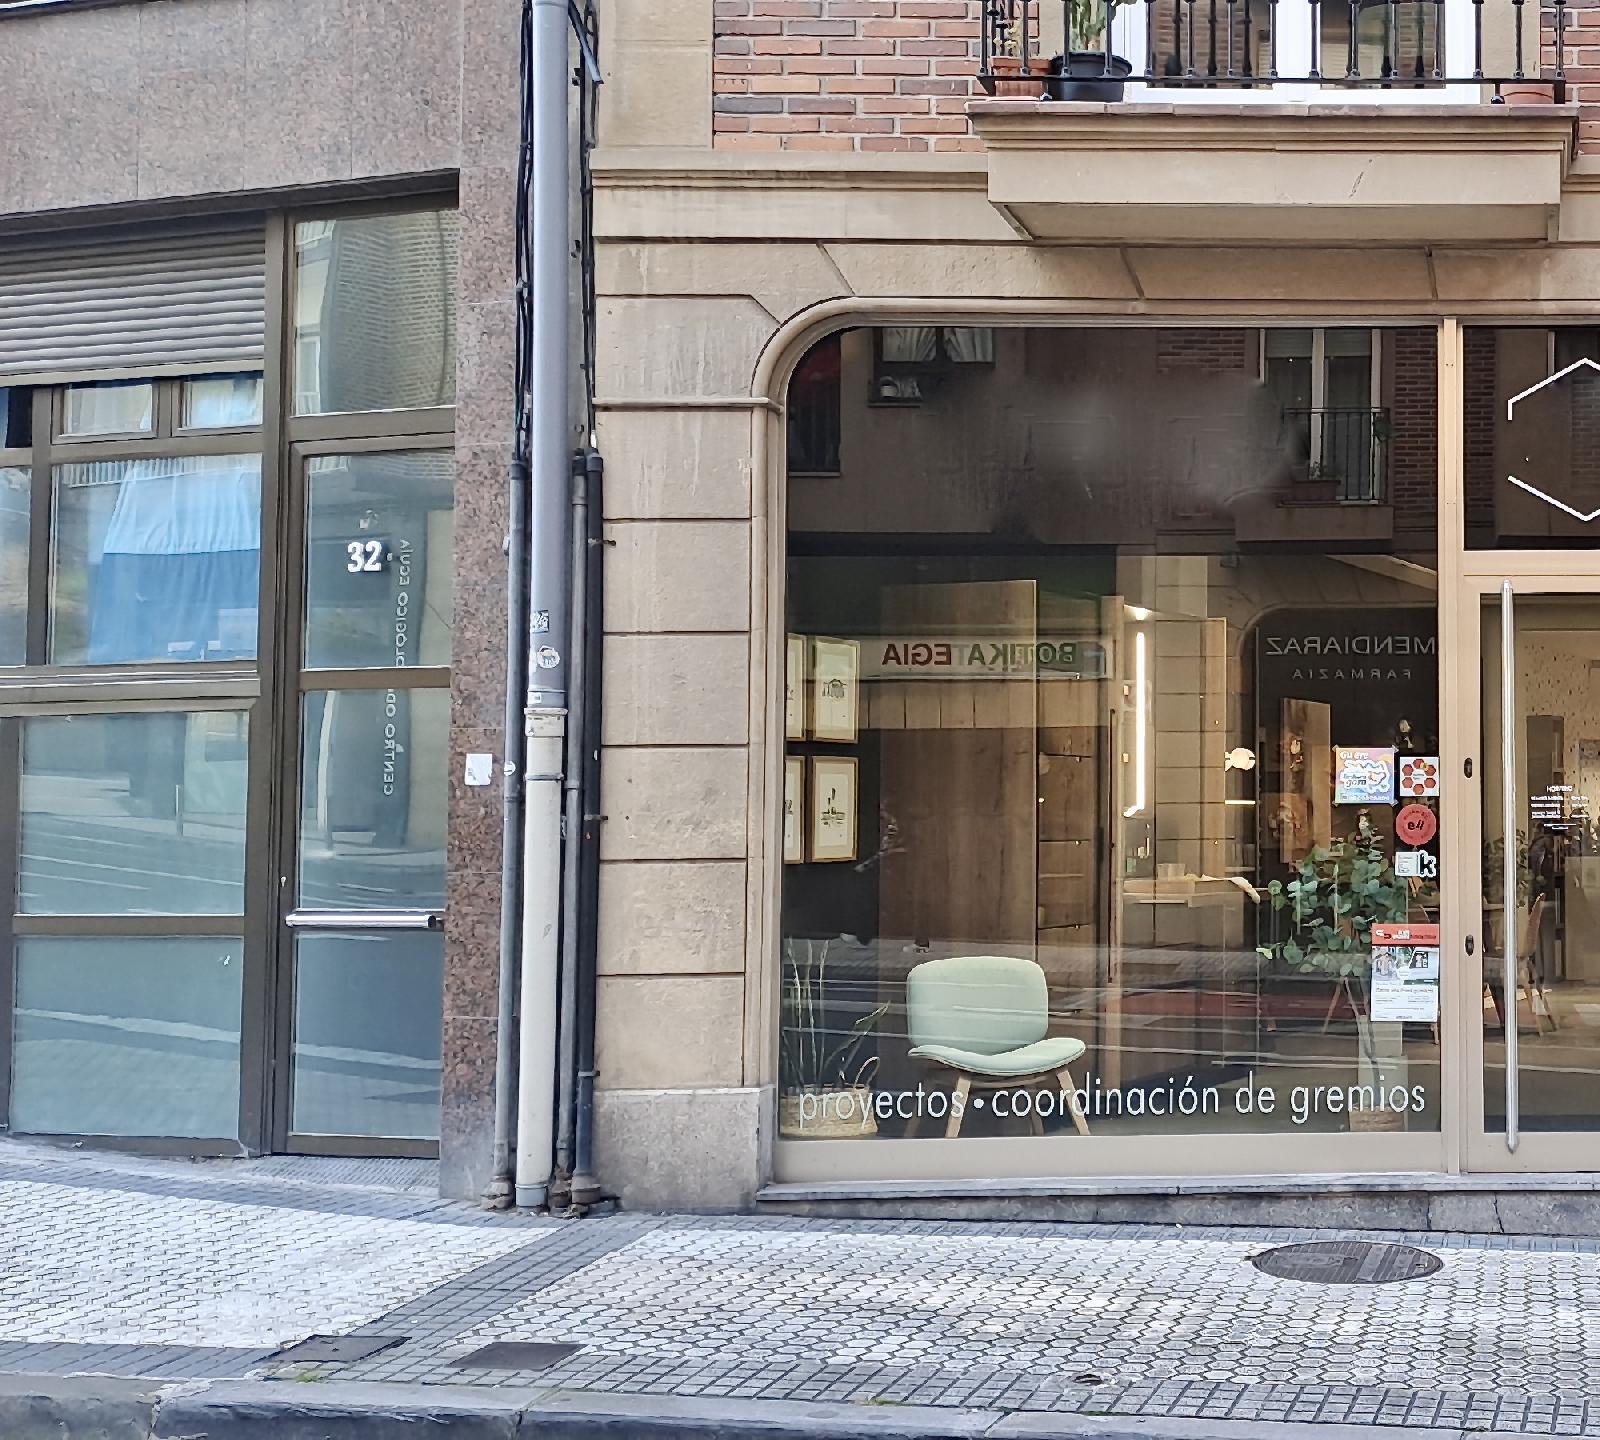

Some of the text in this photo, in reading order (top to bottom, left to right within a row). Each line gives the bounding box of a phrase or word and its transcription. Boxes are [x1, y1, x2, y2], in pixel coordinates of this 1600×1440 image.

[347, 541, 383, 573] 32
[798, 1070, 1426, 1129] proyectos coordinación de gremios
